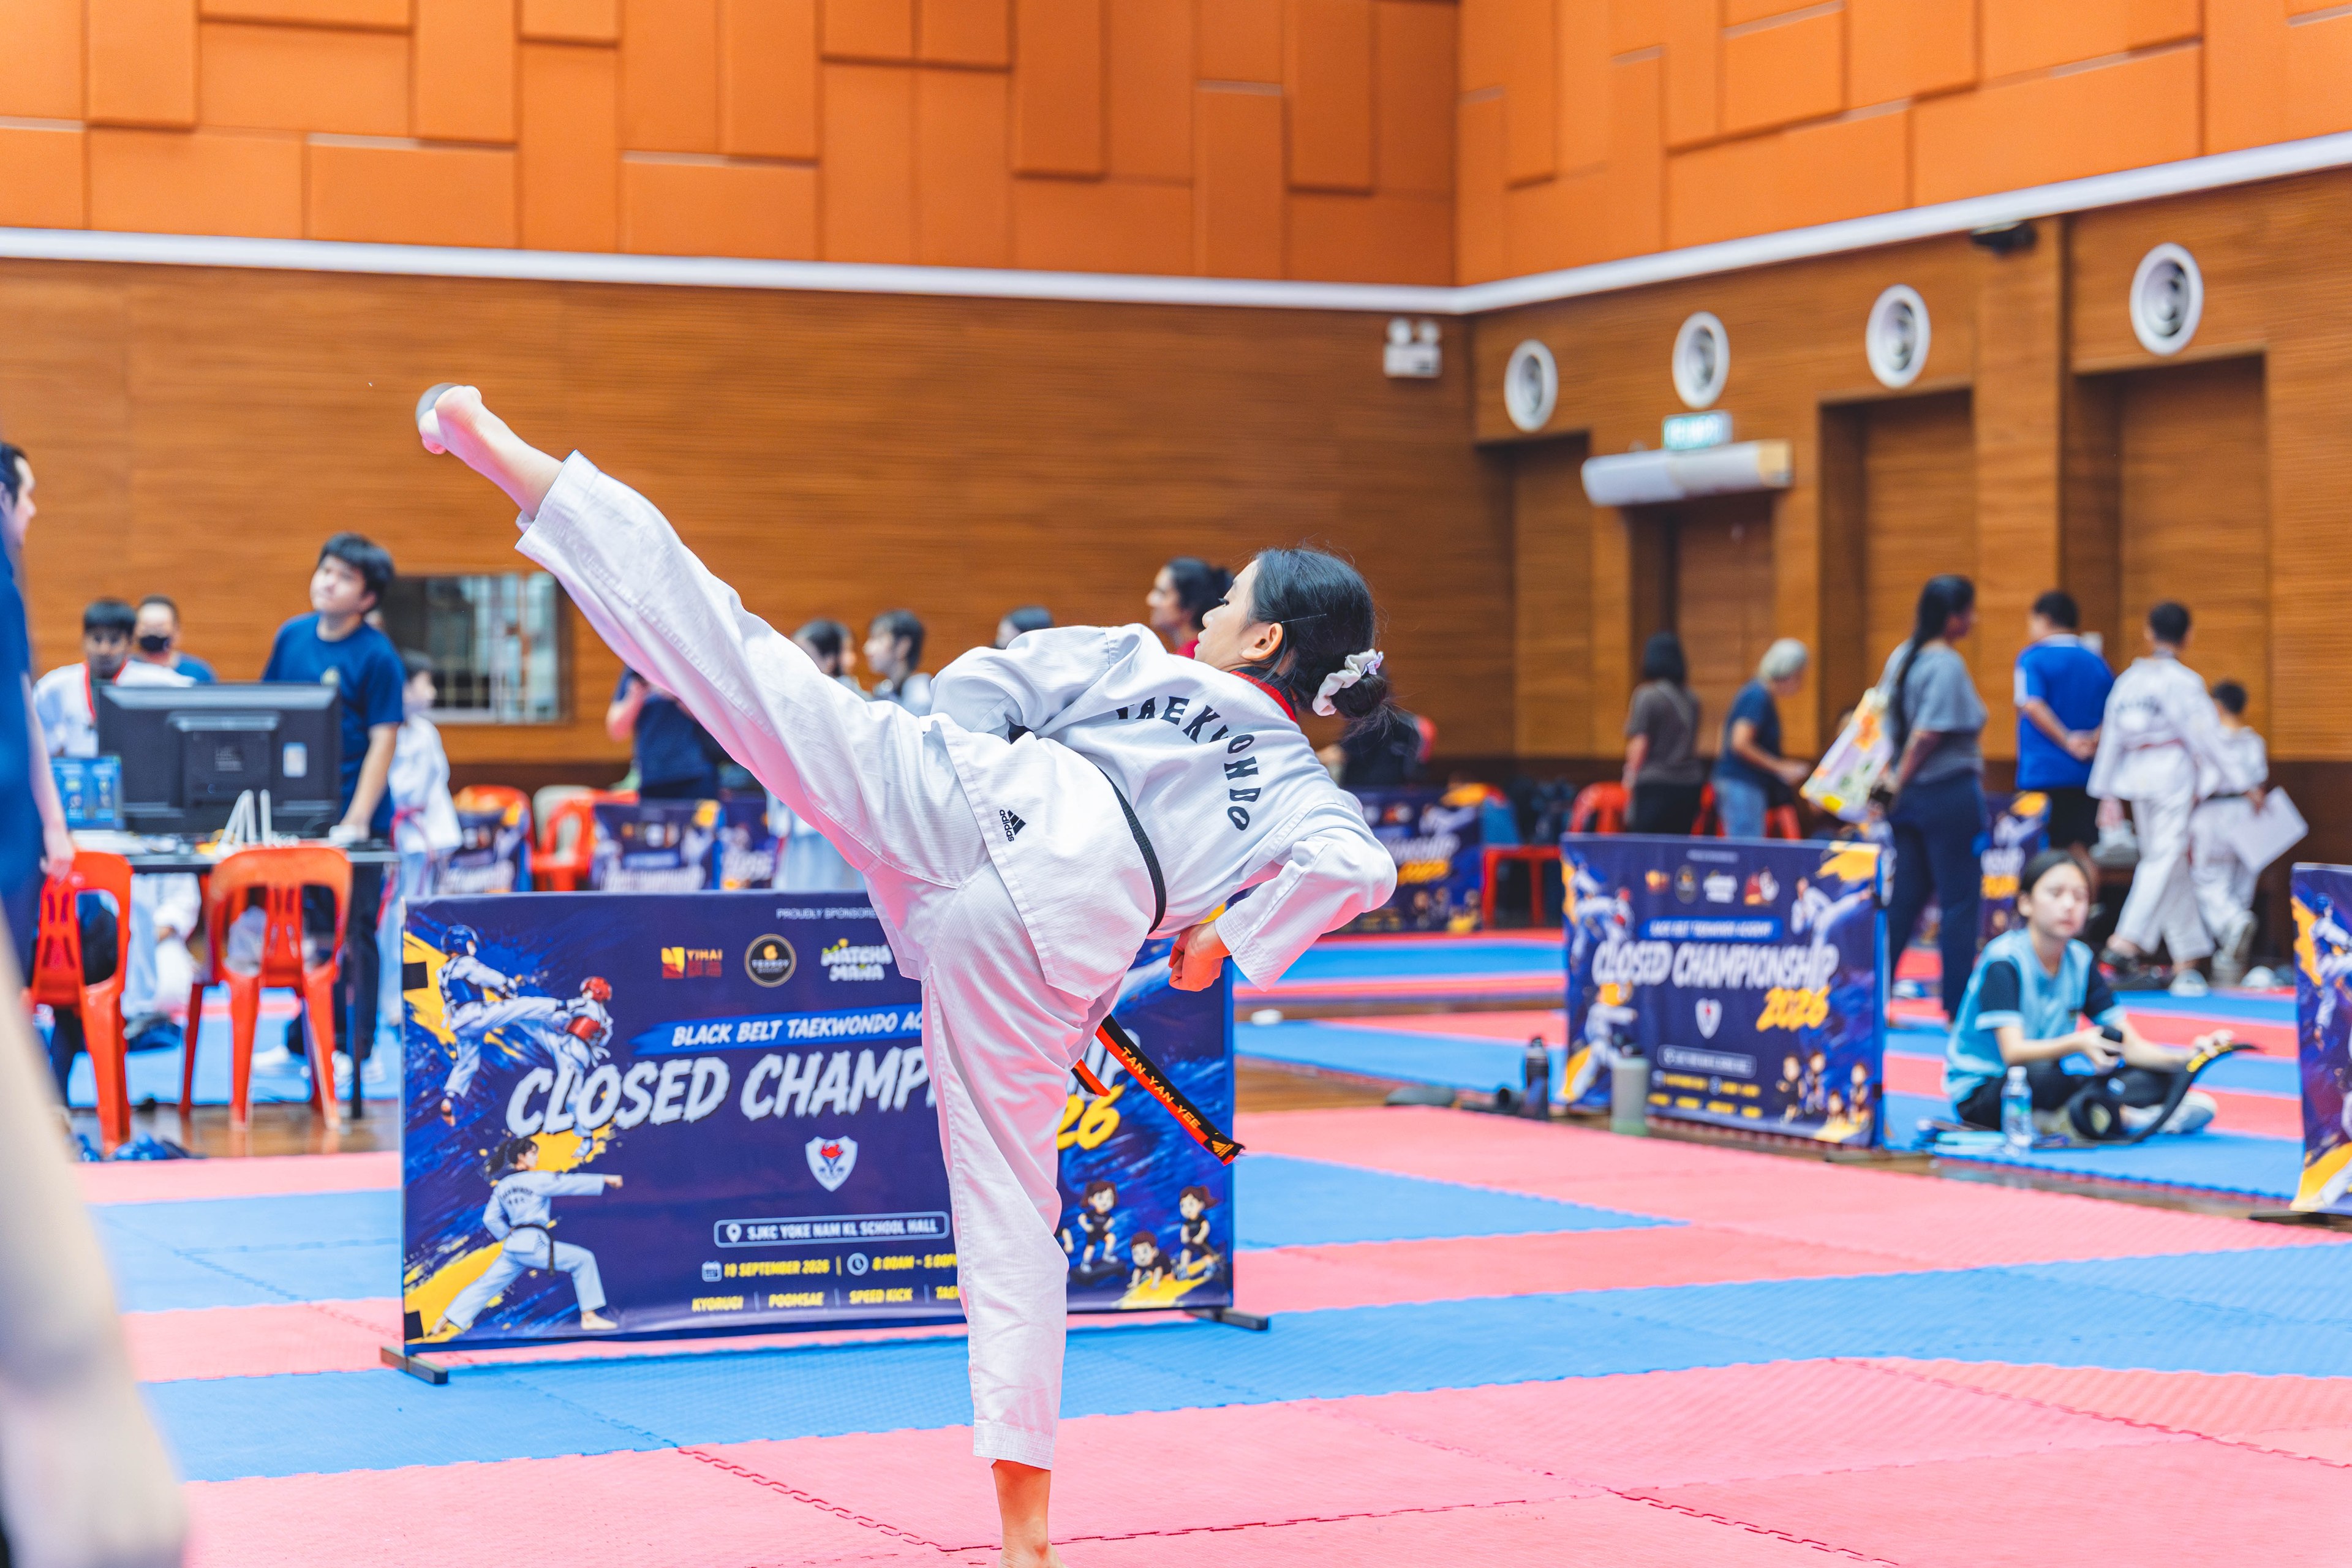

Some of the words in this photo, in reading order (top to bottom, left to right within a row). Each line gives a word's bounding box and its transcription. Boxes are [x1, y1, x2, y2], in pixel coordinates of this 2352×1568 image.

[999, 809, 1014, 842] adidas
[1591, 940, 1674, 987] CLOSED
[671, 1023, 733, 1047] BLACK
[736, 1019, 783, 1043] BELT
[787, 1012, 899, 1039] TAEKWONDO
[900, 1011, 922, 1031] AC
[505, 1056, 731, 1137] CLOSED
[740, 1045, 937, 1121] CHAMP
[1121, 1046, 1147, 1075] TAN
[1149, 1076, 1175, 1104] YAN
[1177, 1104, 1202, 1129] YEE
[1056, 1084, 1126, 1150] 26
[859, 1219, 907, 1236] SCHOOL
